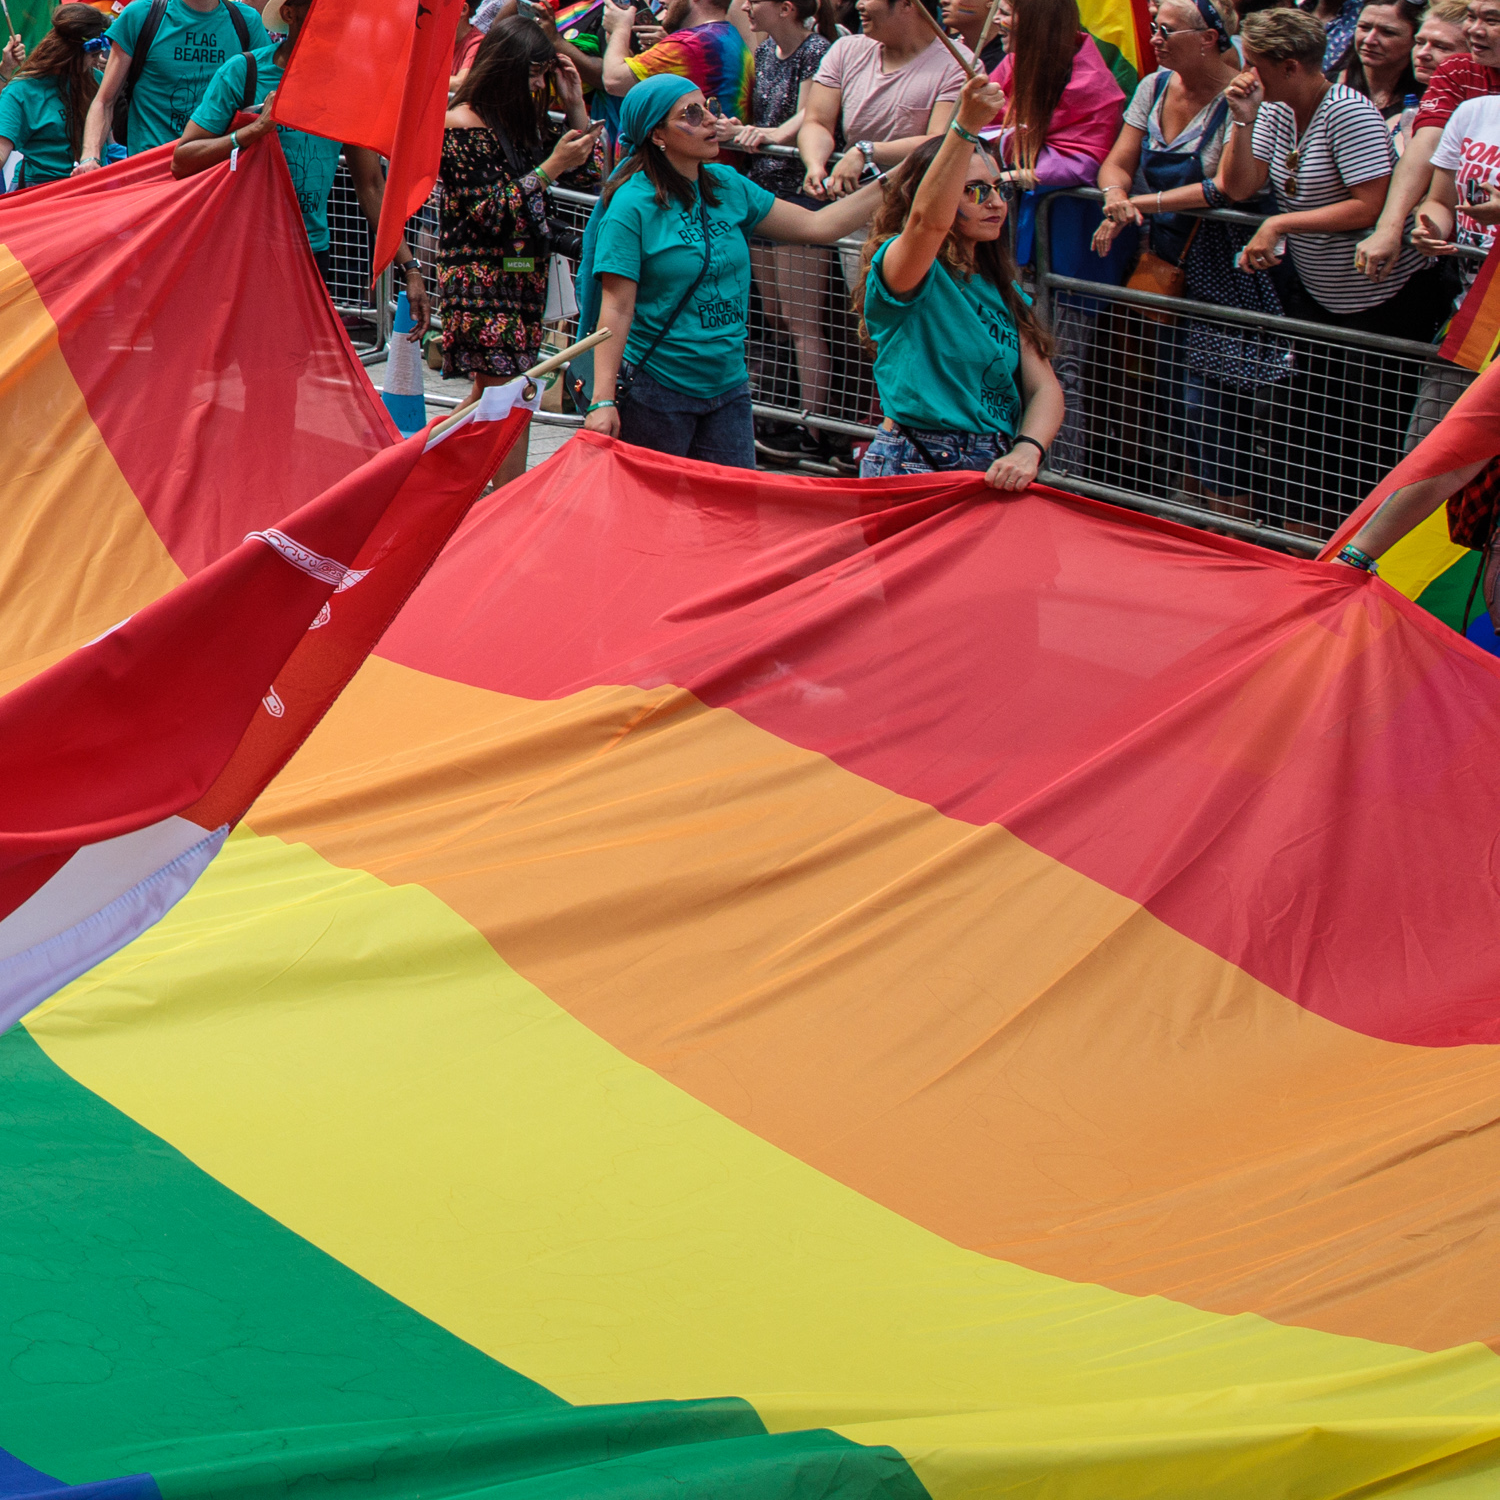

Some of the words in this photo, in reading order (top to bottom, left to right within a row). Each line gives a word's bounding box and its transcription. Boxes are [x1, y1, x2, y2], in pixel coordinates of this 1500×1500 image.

[184, 31, 217, 47] FLAG
[173, 46, 225, 63] BEARER
[698, 300, 733, 318] PRIDE
[700, 309, 744, 329] LONDON
[981, 389, 1010, 409] PRIDE
